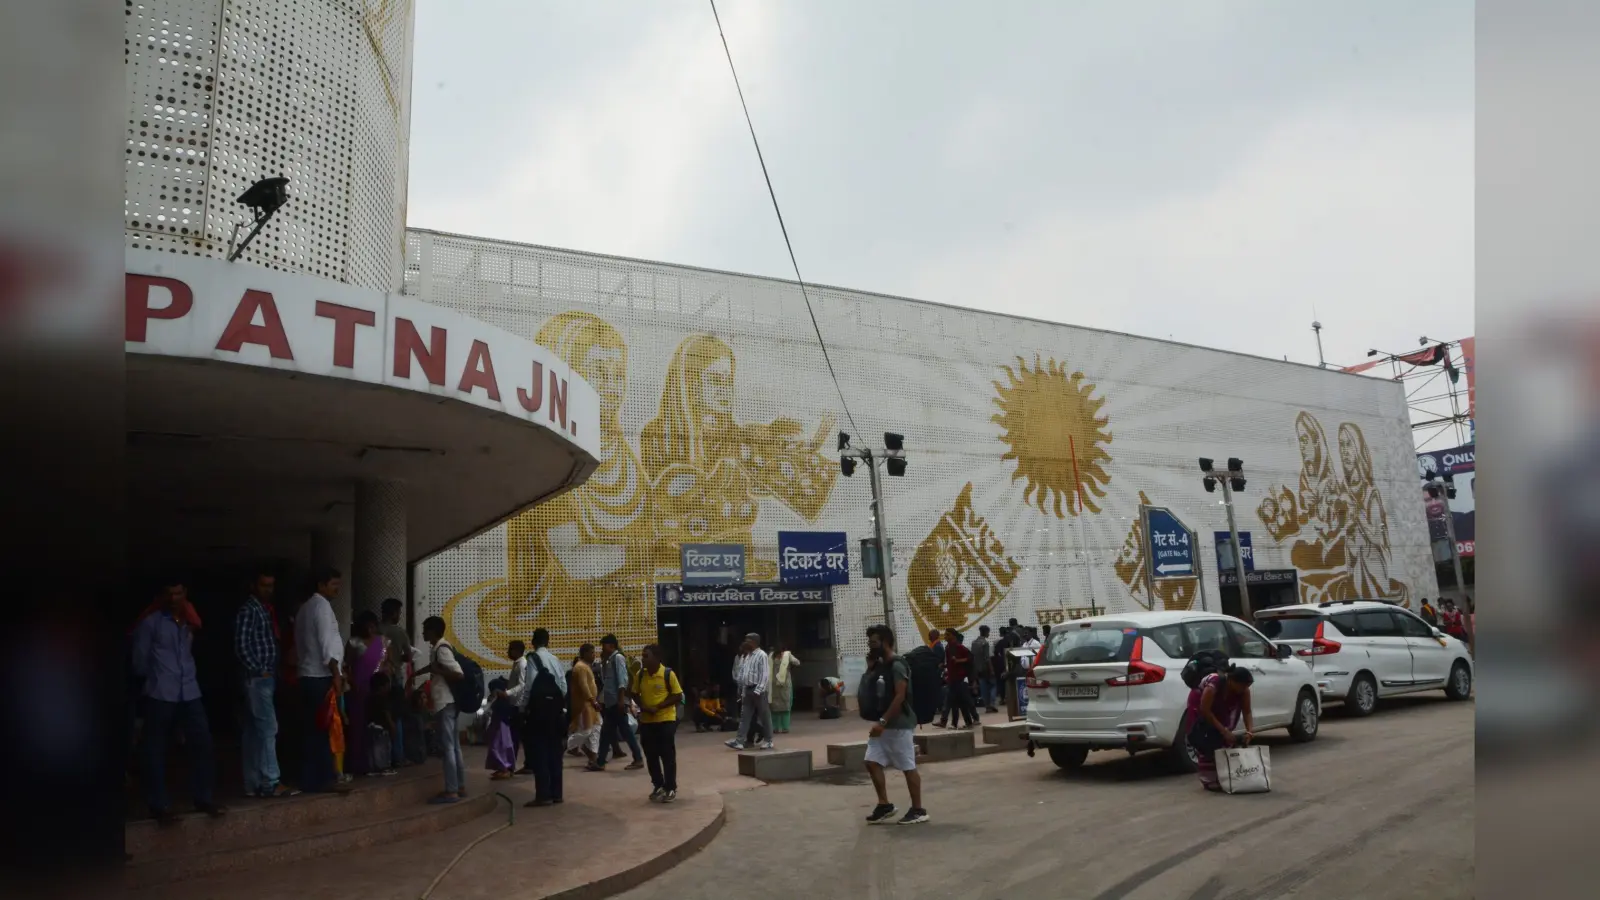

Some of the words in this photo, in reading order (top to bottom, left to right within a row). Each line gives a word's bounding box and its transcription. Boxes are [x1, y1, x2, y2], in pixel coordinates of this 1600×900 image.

[125, 272, 501, 401] PATNA
[516, 359, 577, 437] JN.
[1153, 530, 1167, 546] गेट
[685, 550, 721, 567] टिकट
[723, 554, 741, 567] घर
[783, 547, 822, 570] टिकट
[824, 552, 845, 570] घर
[759, 588, 799, 601] टिकट
[802, 590, 823, 601] घर
